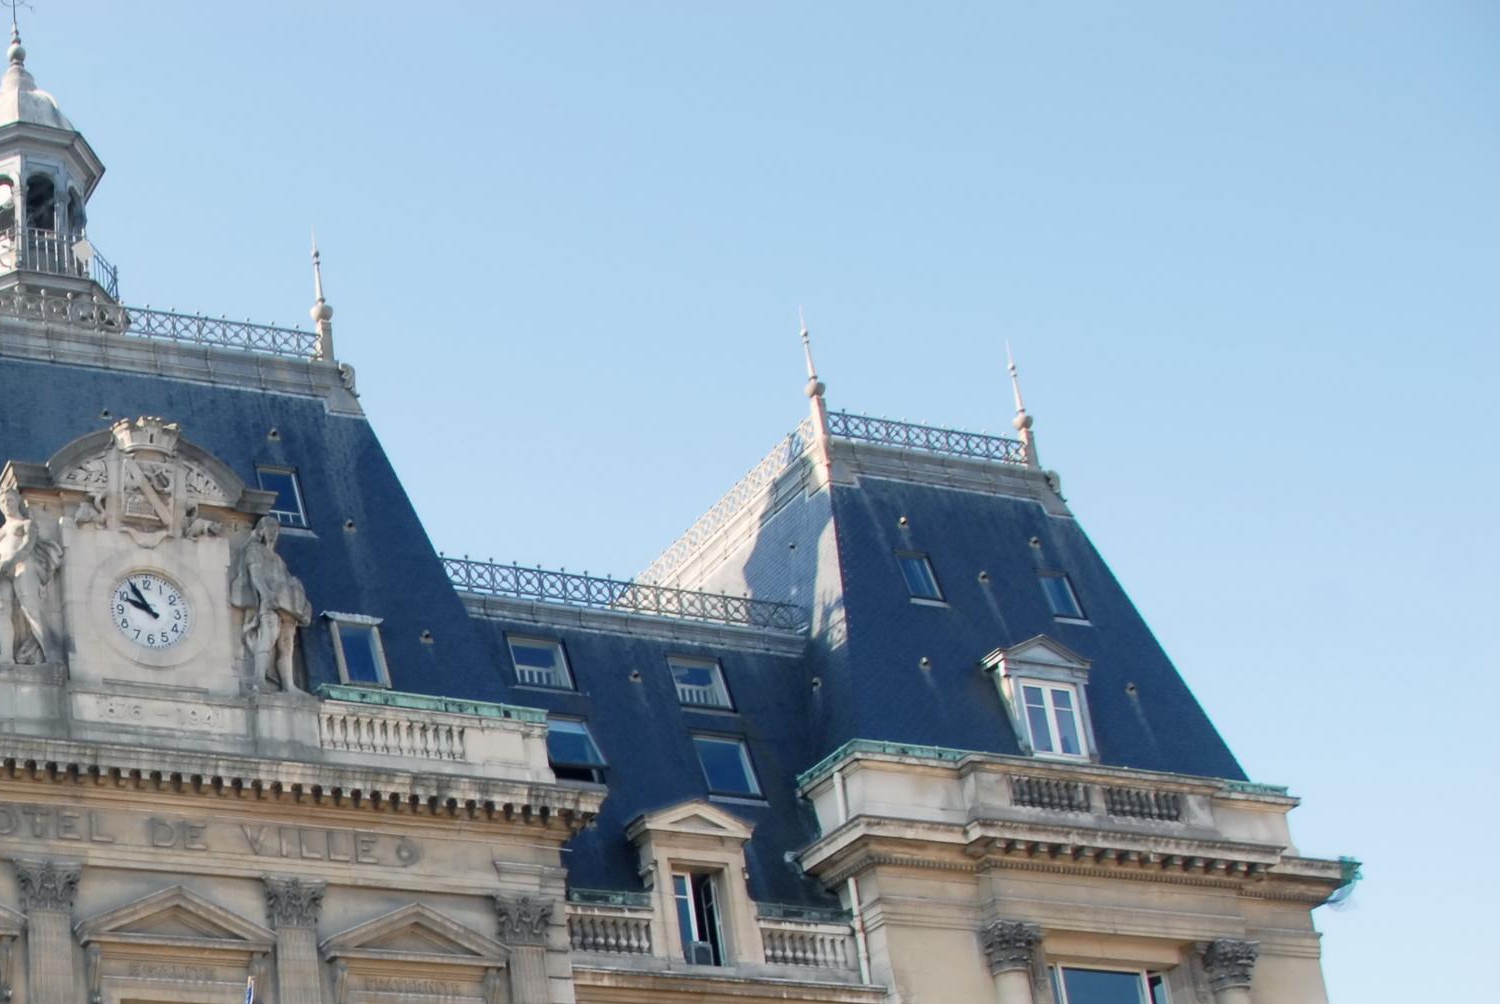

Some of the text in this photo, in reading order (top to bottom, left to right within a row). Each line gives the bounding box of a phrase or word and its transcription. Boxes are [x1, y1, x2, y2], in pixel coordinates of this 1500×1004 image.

[143, 579, 151, 591] 12
[120, 591, 129, 602] 10
[168, 594, 176, 606] 2
[116, 604, 124, 615] 9
[174, 609, 181, 620] 3
[121, 618, 129, 629] 8
[171, 623, 179, 633] 4
[133, 628, 141, 640] 7
[147, 633, 155, 645] 6
[161, 631, 169, 643] 5
[149, 816, 208, 851] DE
[239, 822, 378, 865] VILLE
